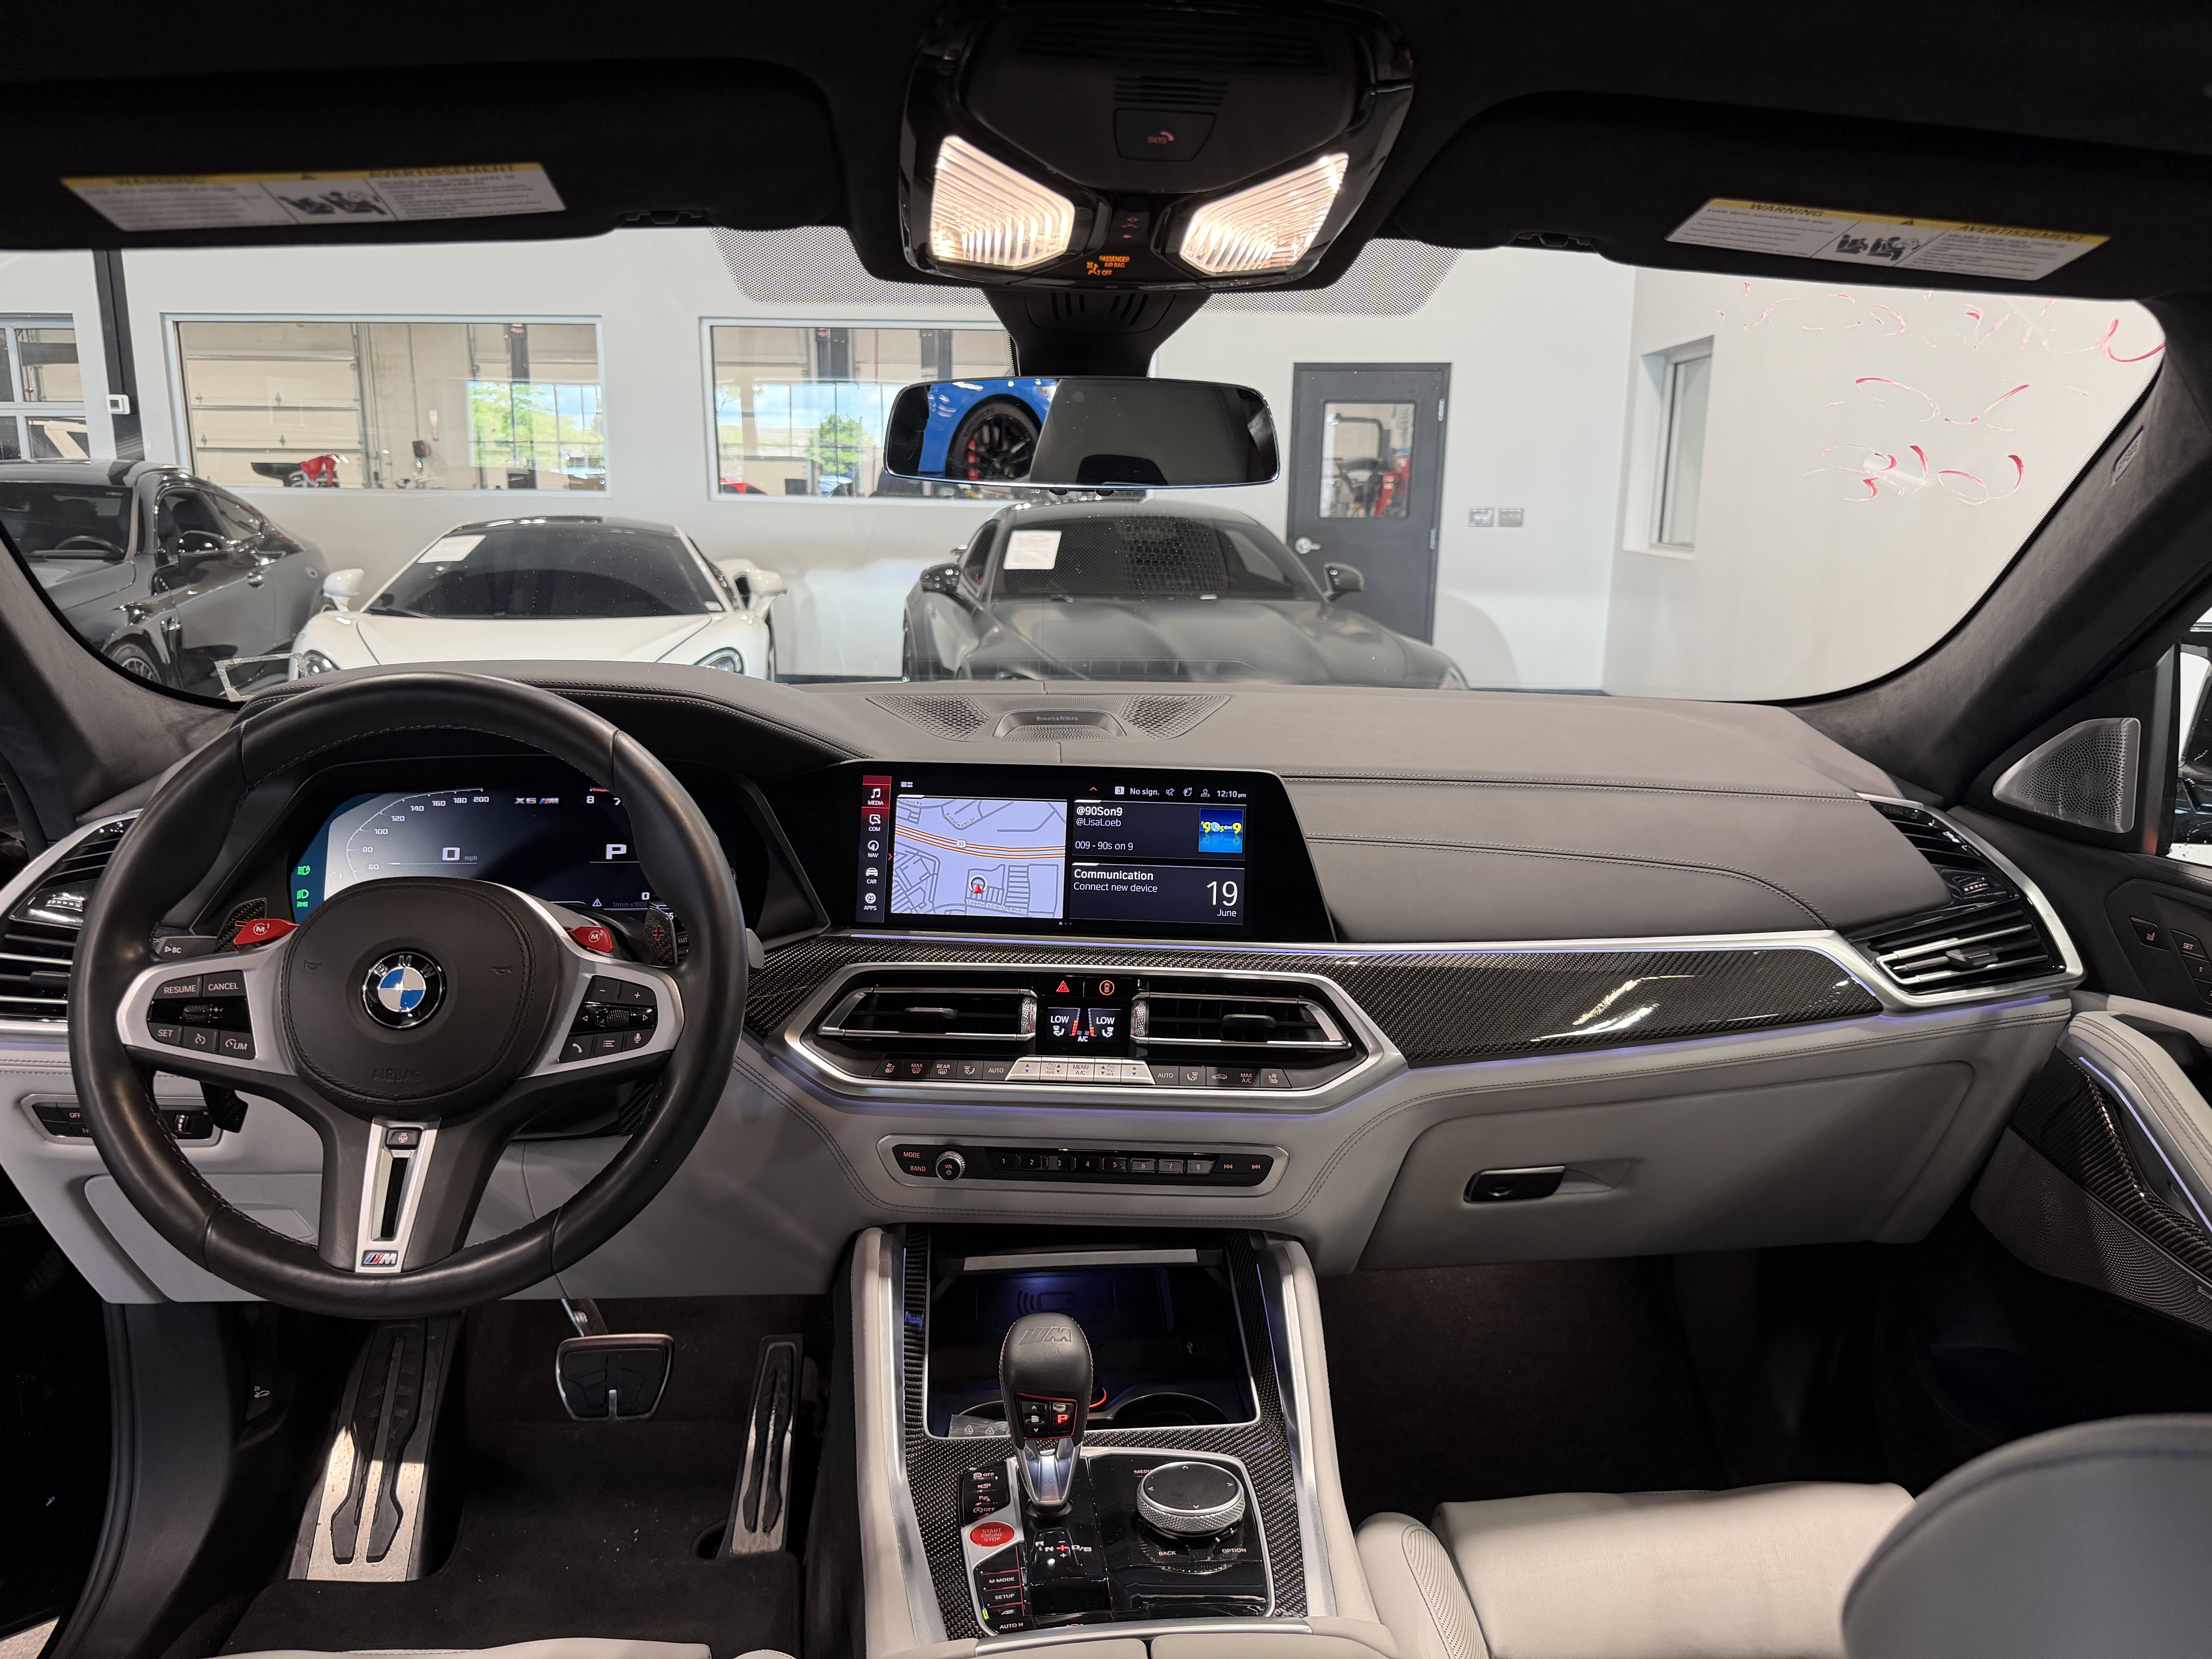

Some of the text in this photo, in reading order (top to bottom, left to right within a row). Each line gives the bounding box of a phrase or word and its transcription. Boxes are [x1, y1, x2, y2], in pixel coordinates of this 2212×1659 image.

[1750, 203, 1823, 217] WARNING
[1957, 225, 2083, 242] AVERTISSEMENT
[1142, 788, 1159, 796] sign.
[1077, 806, 1123, 816] @90Son9
[1076, 818, 1121, 827] @LisaLoeb
[1097, 842, 1112, 850] 90s
[442, 847, 460, 861] 0
[606, 844, 627, 859] P
[1074, 869, 1153, 881] Communication
[1074, 882, 1109, 892] Connect
[1207, 881, 1237, 906] 19
[1217, 909, 1237, 917] June
[374, 955, 436, 978] BMW
[164, 985, 196, 994] RESUME
[234, 1042, 247, 1050] LIM
[373, 1068, 421, 1082] AIRBAG
[1058, 1415, 1068, 1424] P
